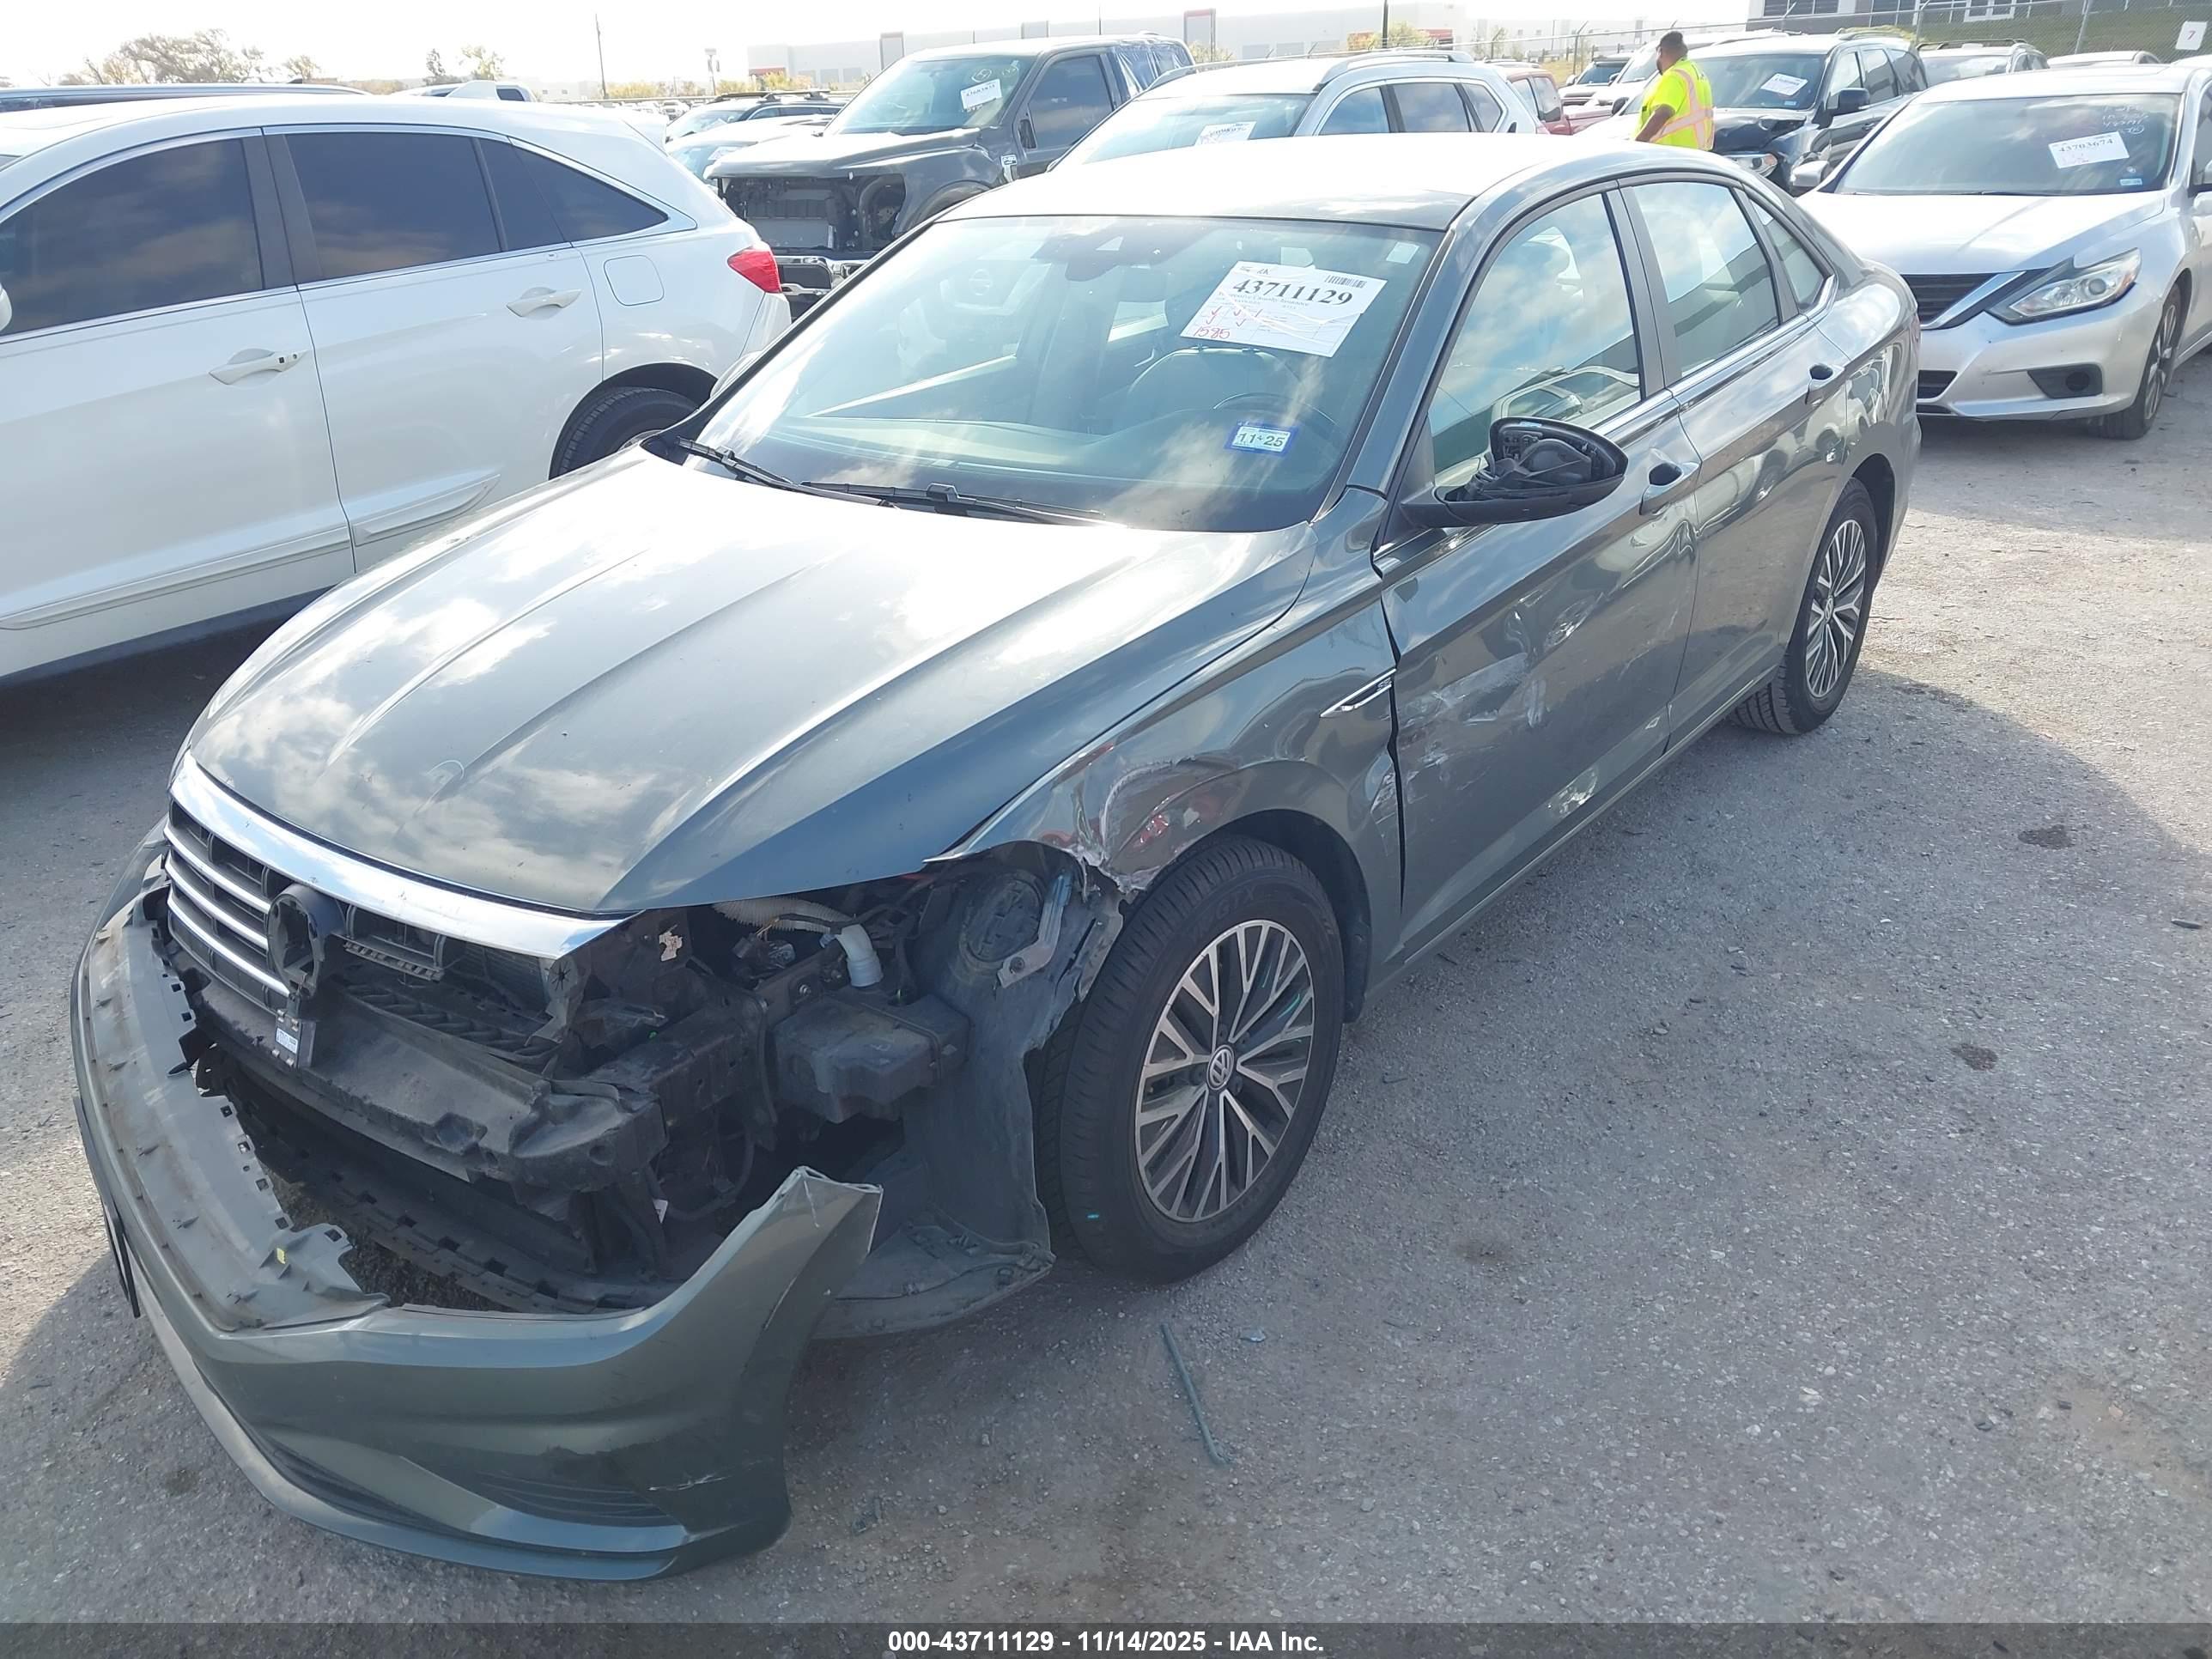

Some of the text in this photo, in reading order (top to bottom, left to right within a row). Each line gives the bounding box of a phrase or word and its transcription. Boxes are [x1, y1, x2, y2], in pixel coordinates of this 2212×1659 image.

[2187, 30, 2197, 41] 7
[1233, 278, 1353, 306] 43711129
[1193, 326, 1231, 339] 1585
